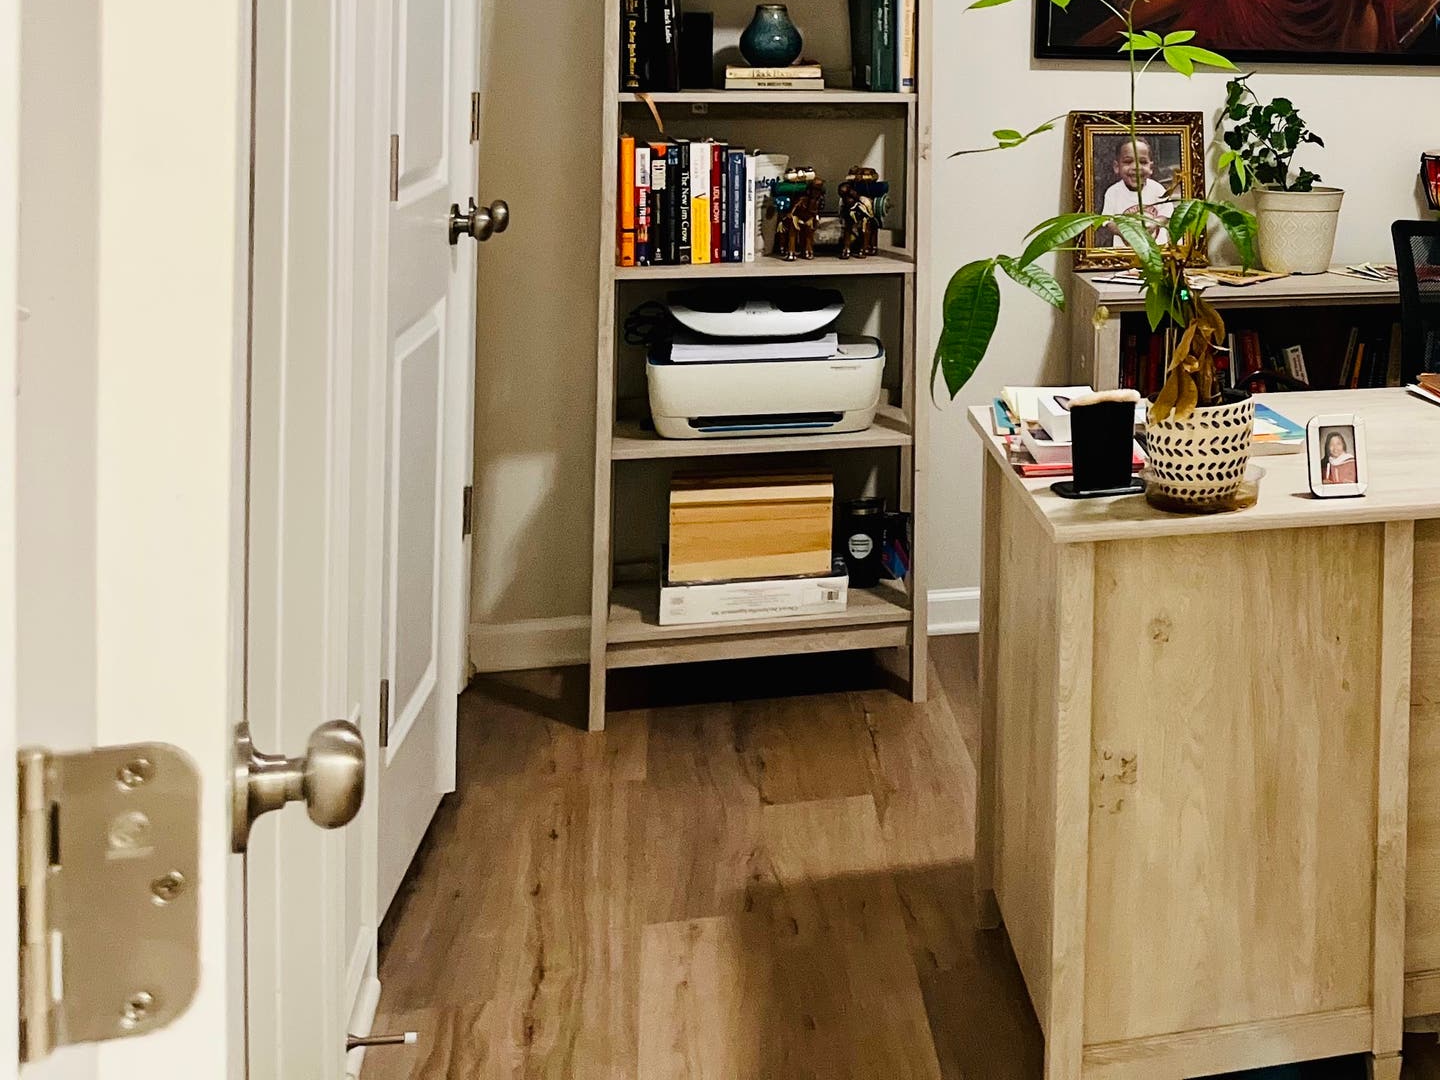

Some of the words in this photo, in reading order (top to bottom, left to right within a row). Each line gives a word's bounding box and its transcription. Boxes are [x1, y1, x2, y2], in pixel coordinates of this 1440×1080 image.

[681, 171, 690, 186] The
[681, 187, 689, 205] New
[680, 206, 690, 220] Jim
[681, 221, 689, 242] Crow
